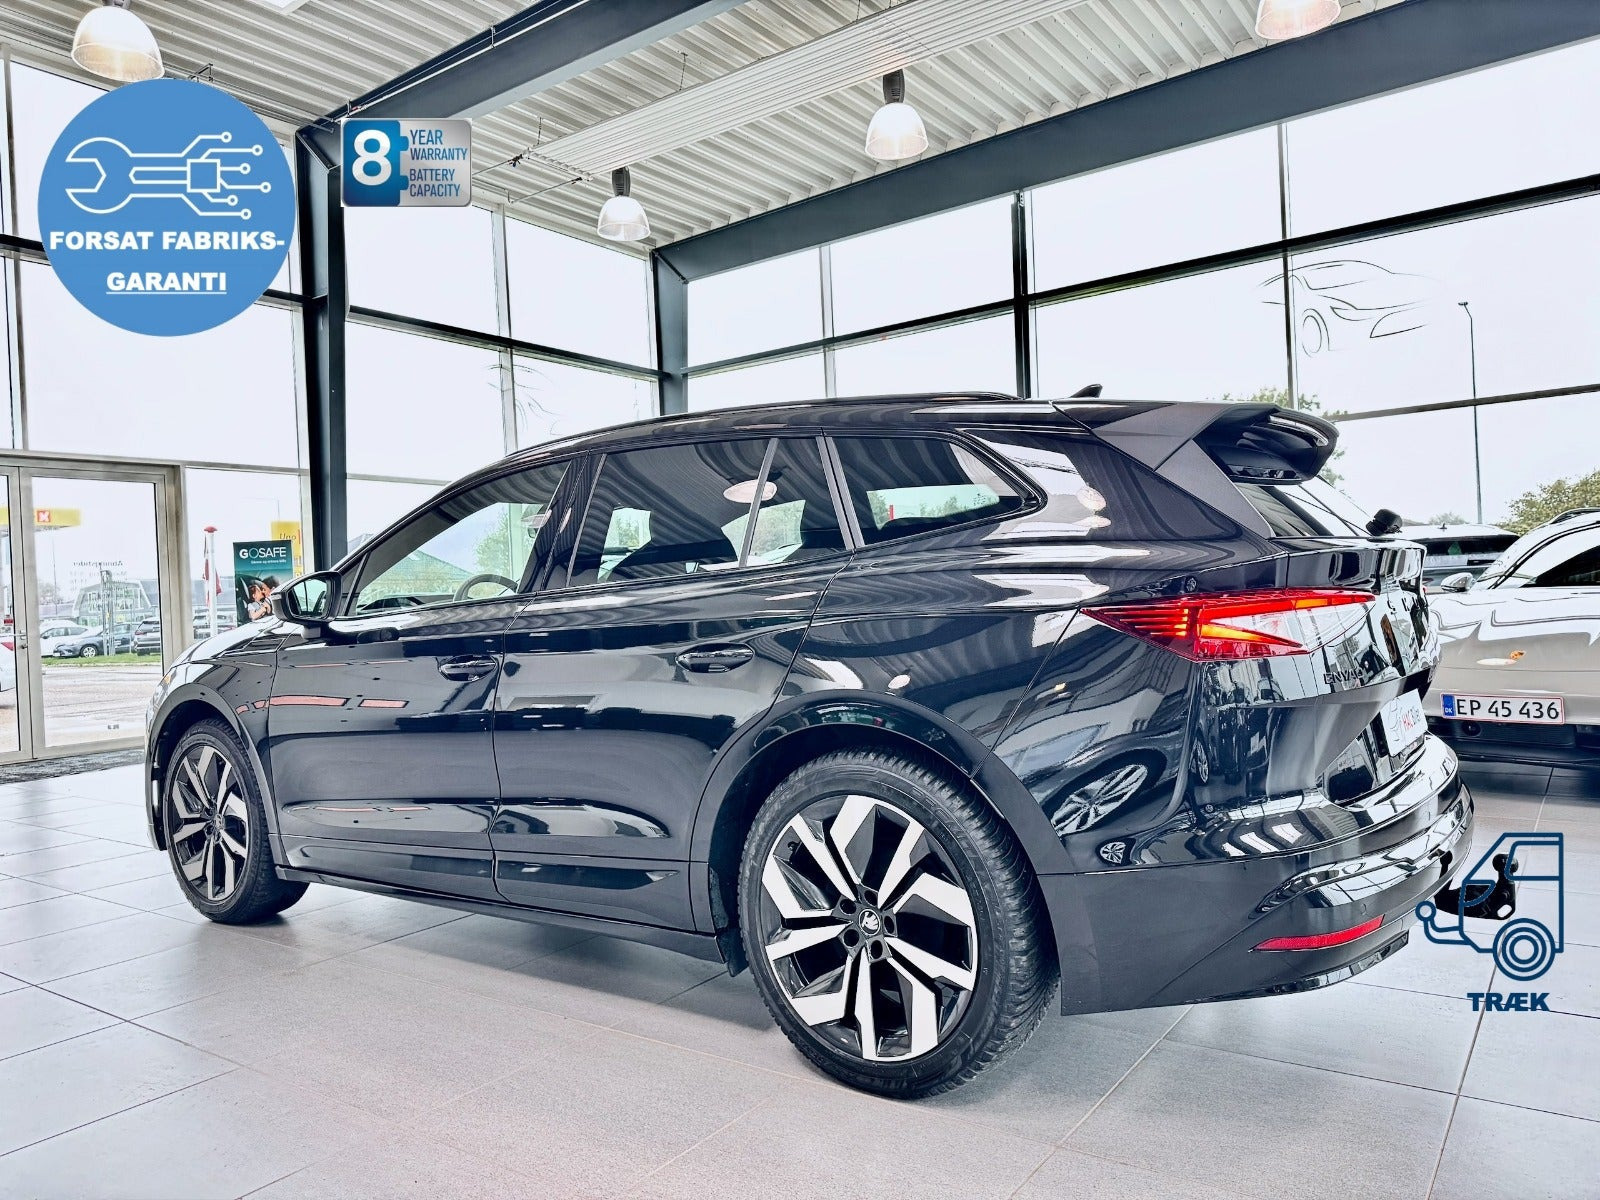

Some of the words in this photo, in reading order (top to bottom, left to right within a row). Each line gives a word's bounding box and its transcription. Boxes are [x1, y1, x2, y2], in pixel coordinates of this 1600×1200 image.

[1456, 699, 1481, 715] EP
[1488, 700, 1512, 717] 45
[1519, 702, 1560, 719] 436
